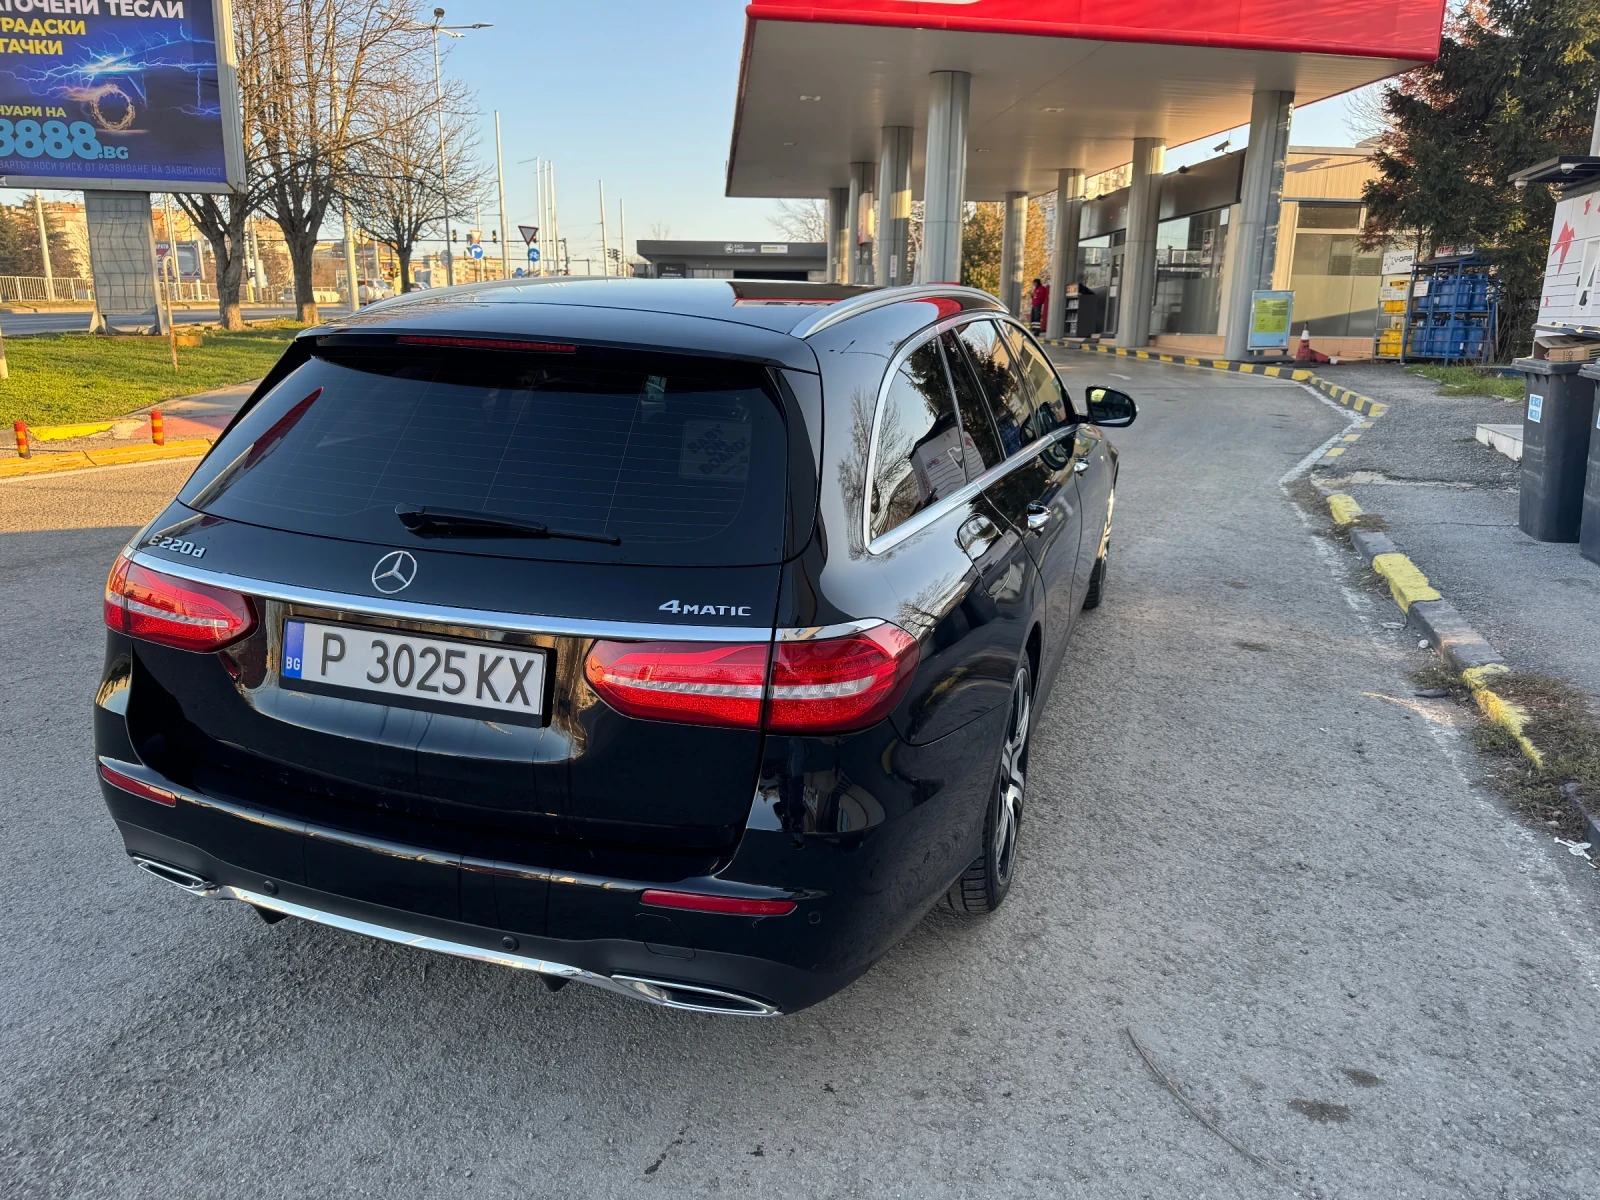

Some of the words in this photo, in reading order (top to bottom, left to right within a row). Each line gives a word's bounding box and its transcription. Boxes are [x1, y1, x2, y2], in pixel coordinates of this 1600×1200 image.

[104, 0, 184, 18] ТЕСЛИ
[45, 106, 67, 118] НА
[33, 161, 57, 171] НОСИ
[60, 162, 83, 171] РИСК
[85, 163, 96, 172] ОТ
[98, 163, 148, 174] РАЗВИВАНЕ
[151, 165, 162, 174] НА
[165, 165, 222, 176] ЗАВИСИМОСТ
[854, 250, 861, 260] 3
[862, 250, 869, 260] 4
[148, 533, 206, 558] E220d
[659, 599, 752, 617] 4MATIC
[320, 631, 346, 677] P
[285, 656, 301, 671] BG
